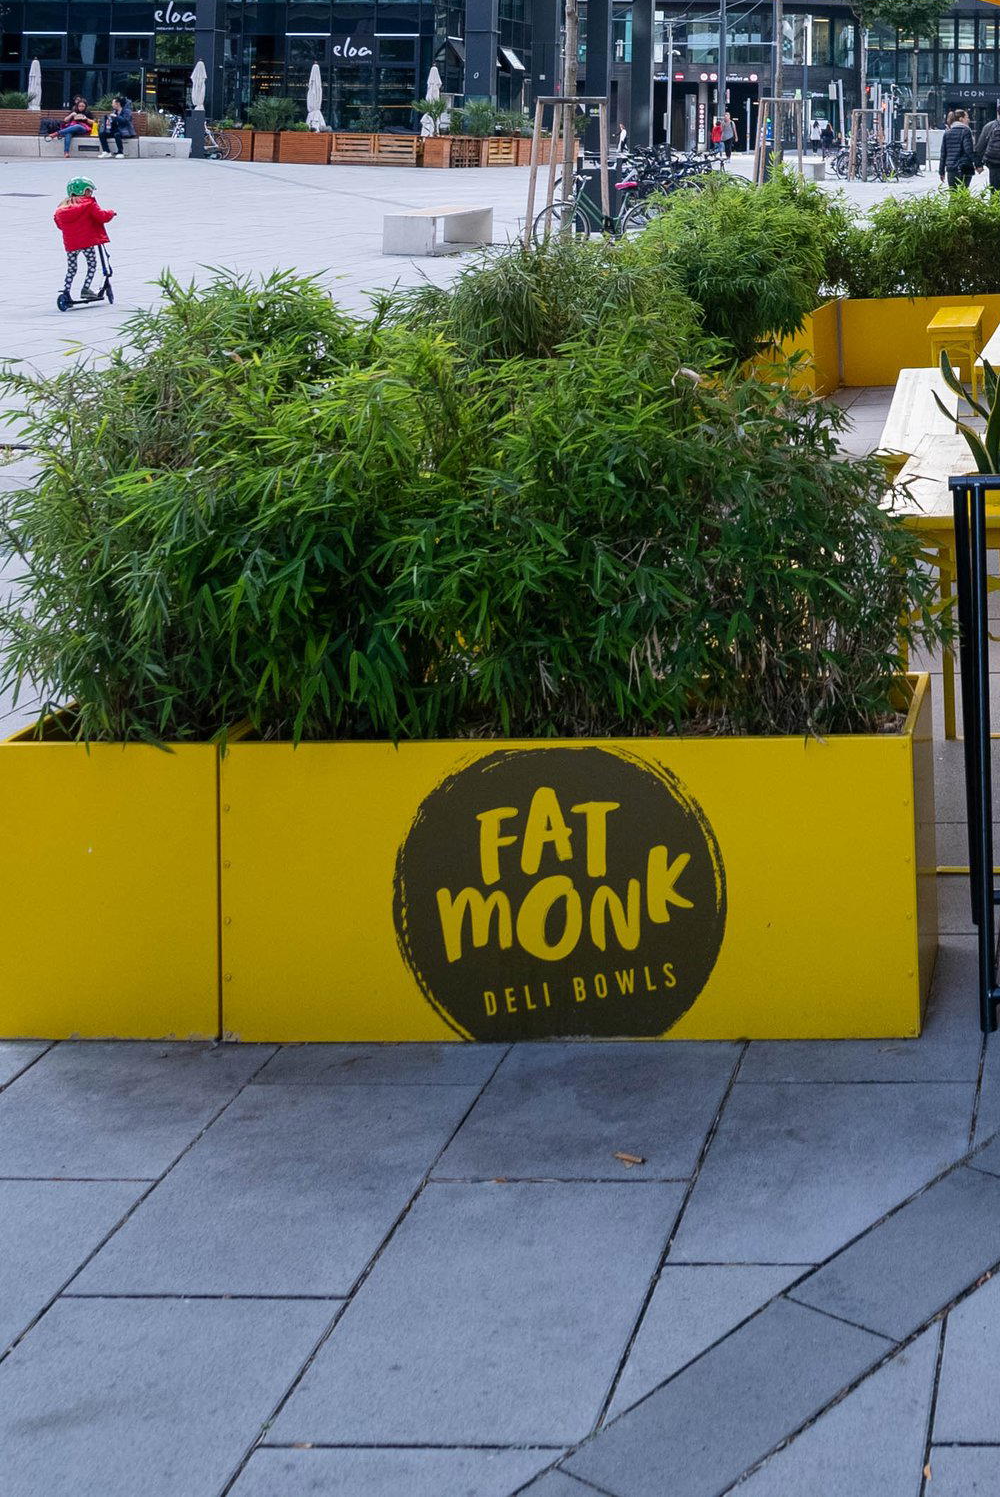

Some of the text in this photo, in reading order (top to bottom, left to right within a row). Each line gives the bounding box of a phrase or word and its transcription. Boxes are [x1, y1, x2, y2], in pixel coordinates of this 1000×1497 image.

[333, 36, 373, 58] eloa
[476, 786, 621, 885] FAT
[436, 844, 694, 963] MONK
[484, 962, 677, 1016] DELI BOWLS
